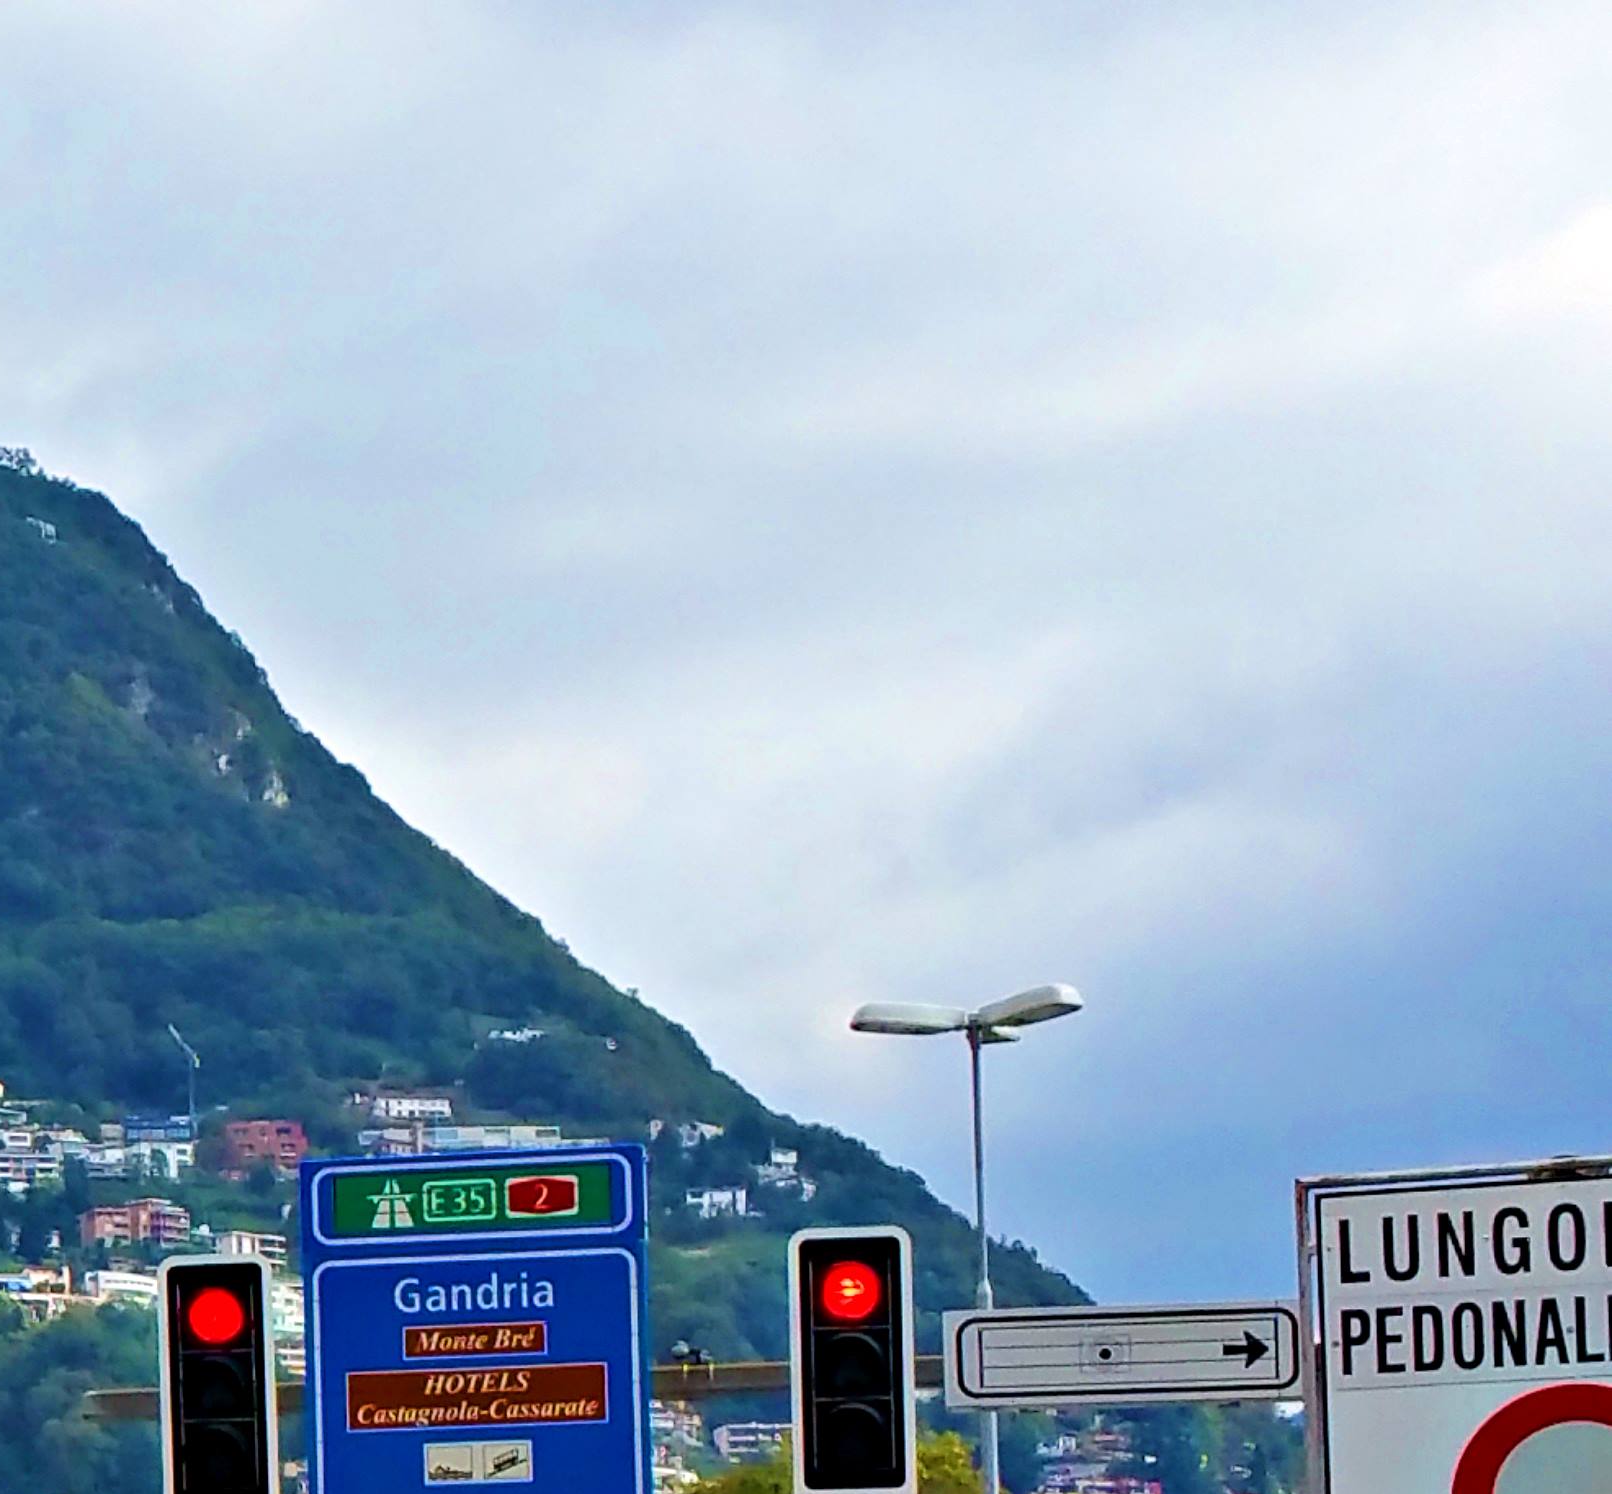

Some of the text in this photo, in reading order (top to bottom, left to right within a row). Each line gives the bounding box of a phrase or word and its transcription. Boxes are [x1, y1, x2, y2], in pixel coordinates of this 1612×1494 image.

[534, 1183, 549, 1210] 2
[393, 1272, 555, 1314] Gandria
[416, 1326, 537, 1353] Monte Bré
[1340, 1295, 1612, 1376] PEDONAL
[424, 1370, 531, 1396] HOTELS
[356, 1399, 600, 1427] Castagnola-Cassarate
